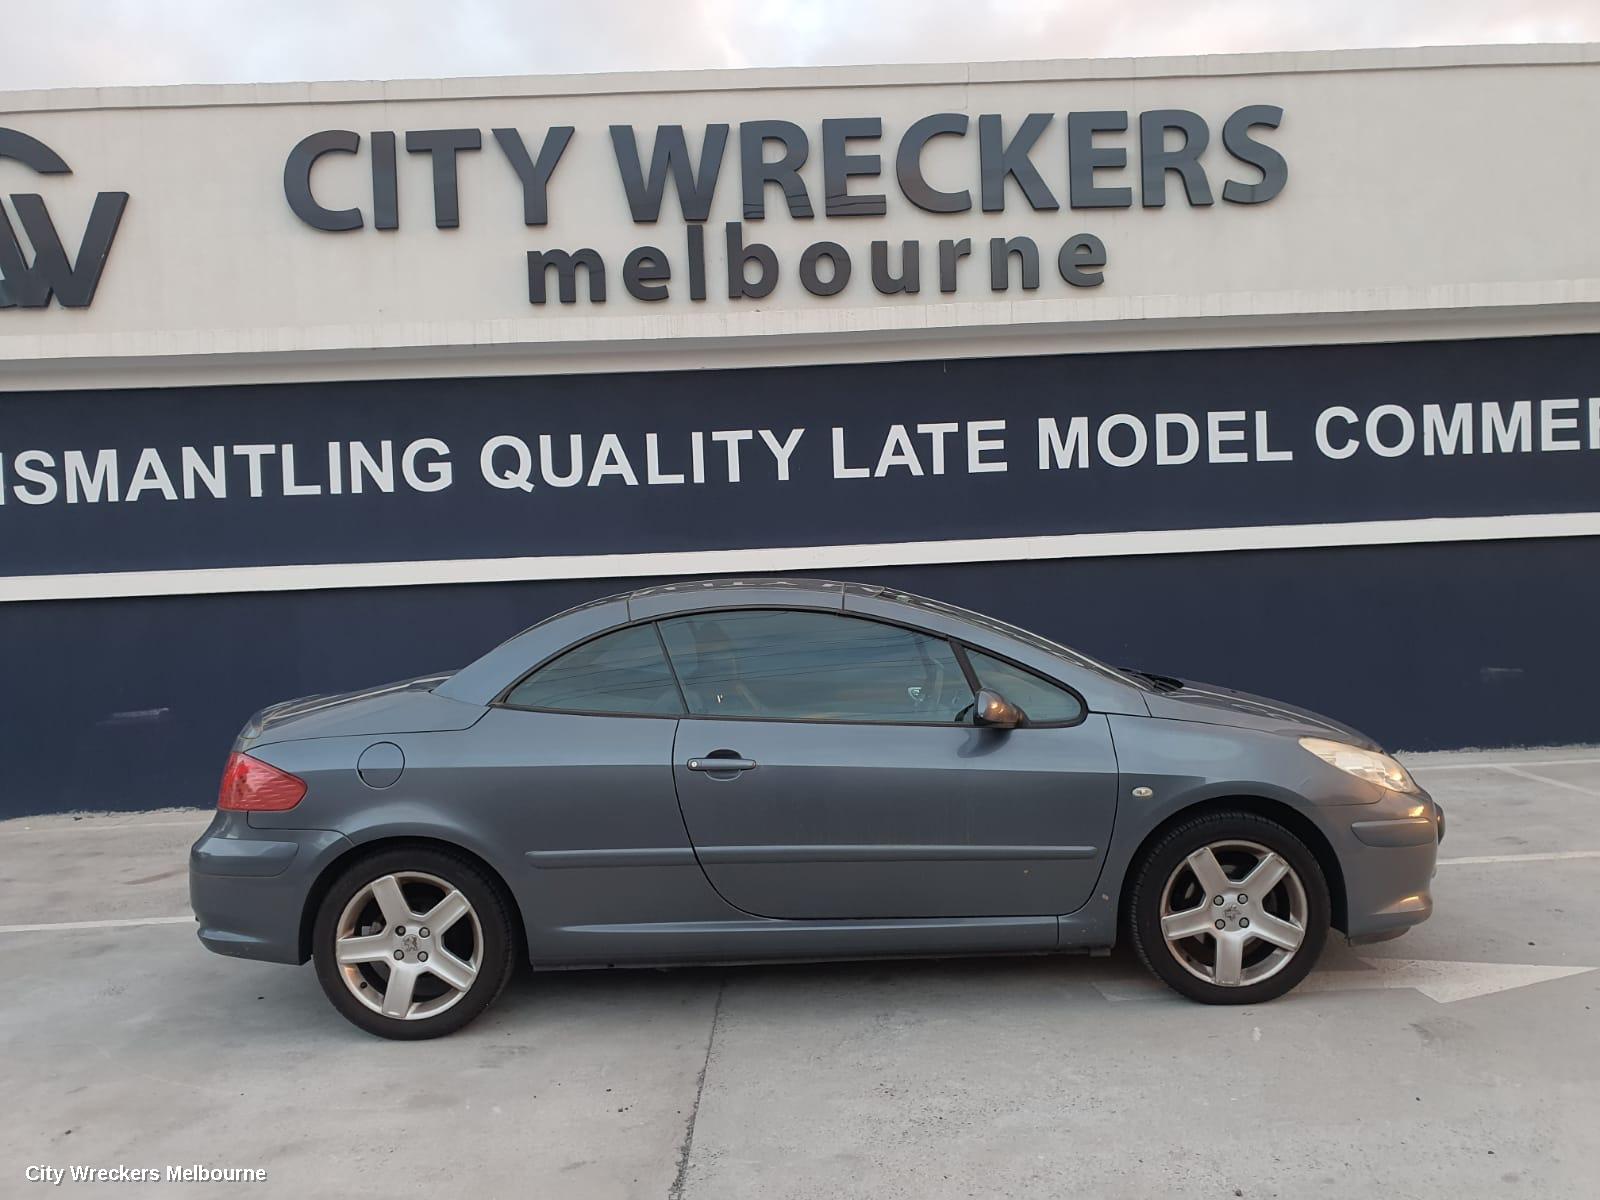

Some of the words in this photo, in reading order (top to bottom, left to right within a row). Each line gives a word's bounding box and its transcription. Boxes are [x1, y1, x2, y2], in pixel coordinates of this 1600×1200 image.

[284, 126, 575, 232] CITY
[609, 105, 1288, 222] WRECKERS
[527, 222, 1107, 304] melbourne
[480, 428, 805, 493] QUALITY
[831, 419, 1008, 479] LATE
[1038, 411, 1293, 470] MODEL
[1315, 397, 1600, 460] COMME
